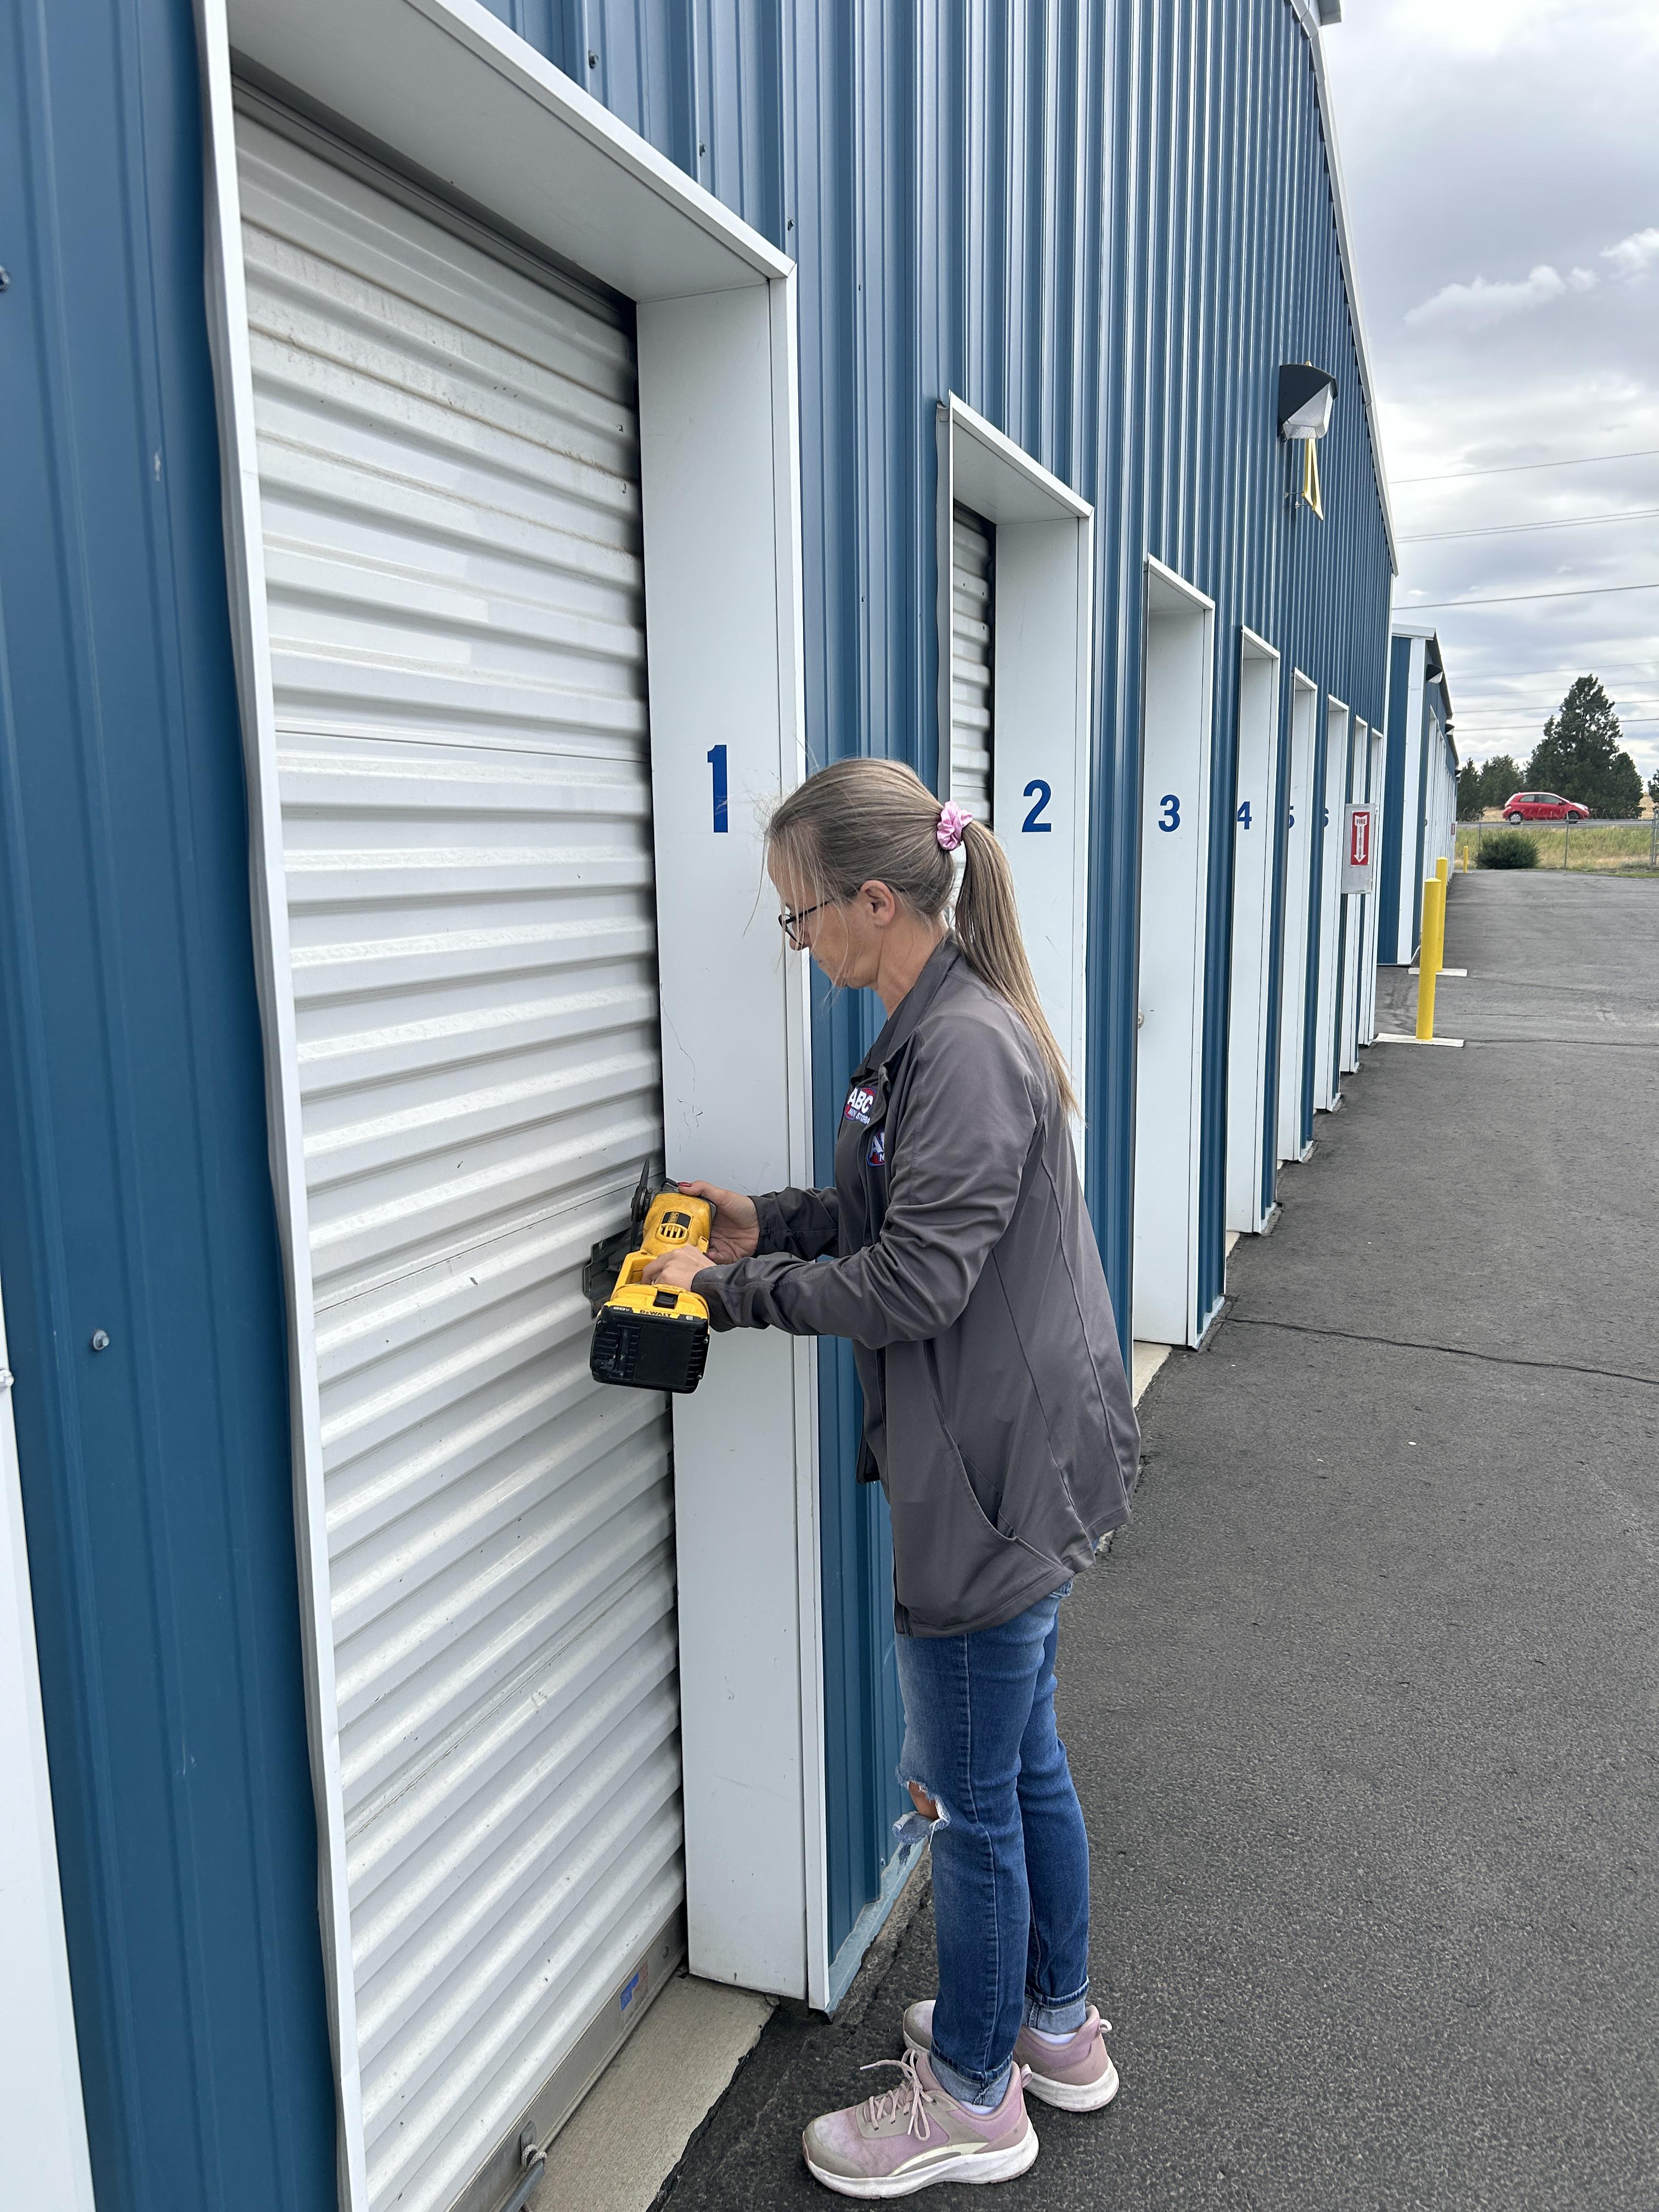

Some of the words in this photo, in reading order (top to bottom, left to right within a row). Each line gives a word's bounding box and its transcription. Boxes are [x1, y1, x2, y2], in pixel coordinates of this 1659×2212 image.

[708, 744, 728, 833] 1
[1022, 779, 1051, 832] 2
[1158, 794, 1180, 832] 3
[1237, 801, 1252, 830] 4
[848, 1088, 873, 1114] ABC
